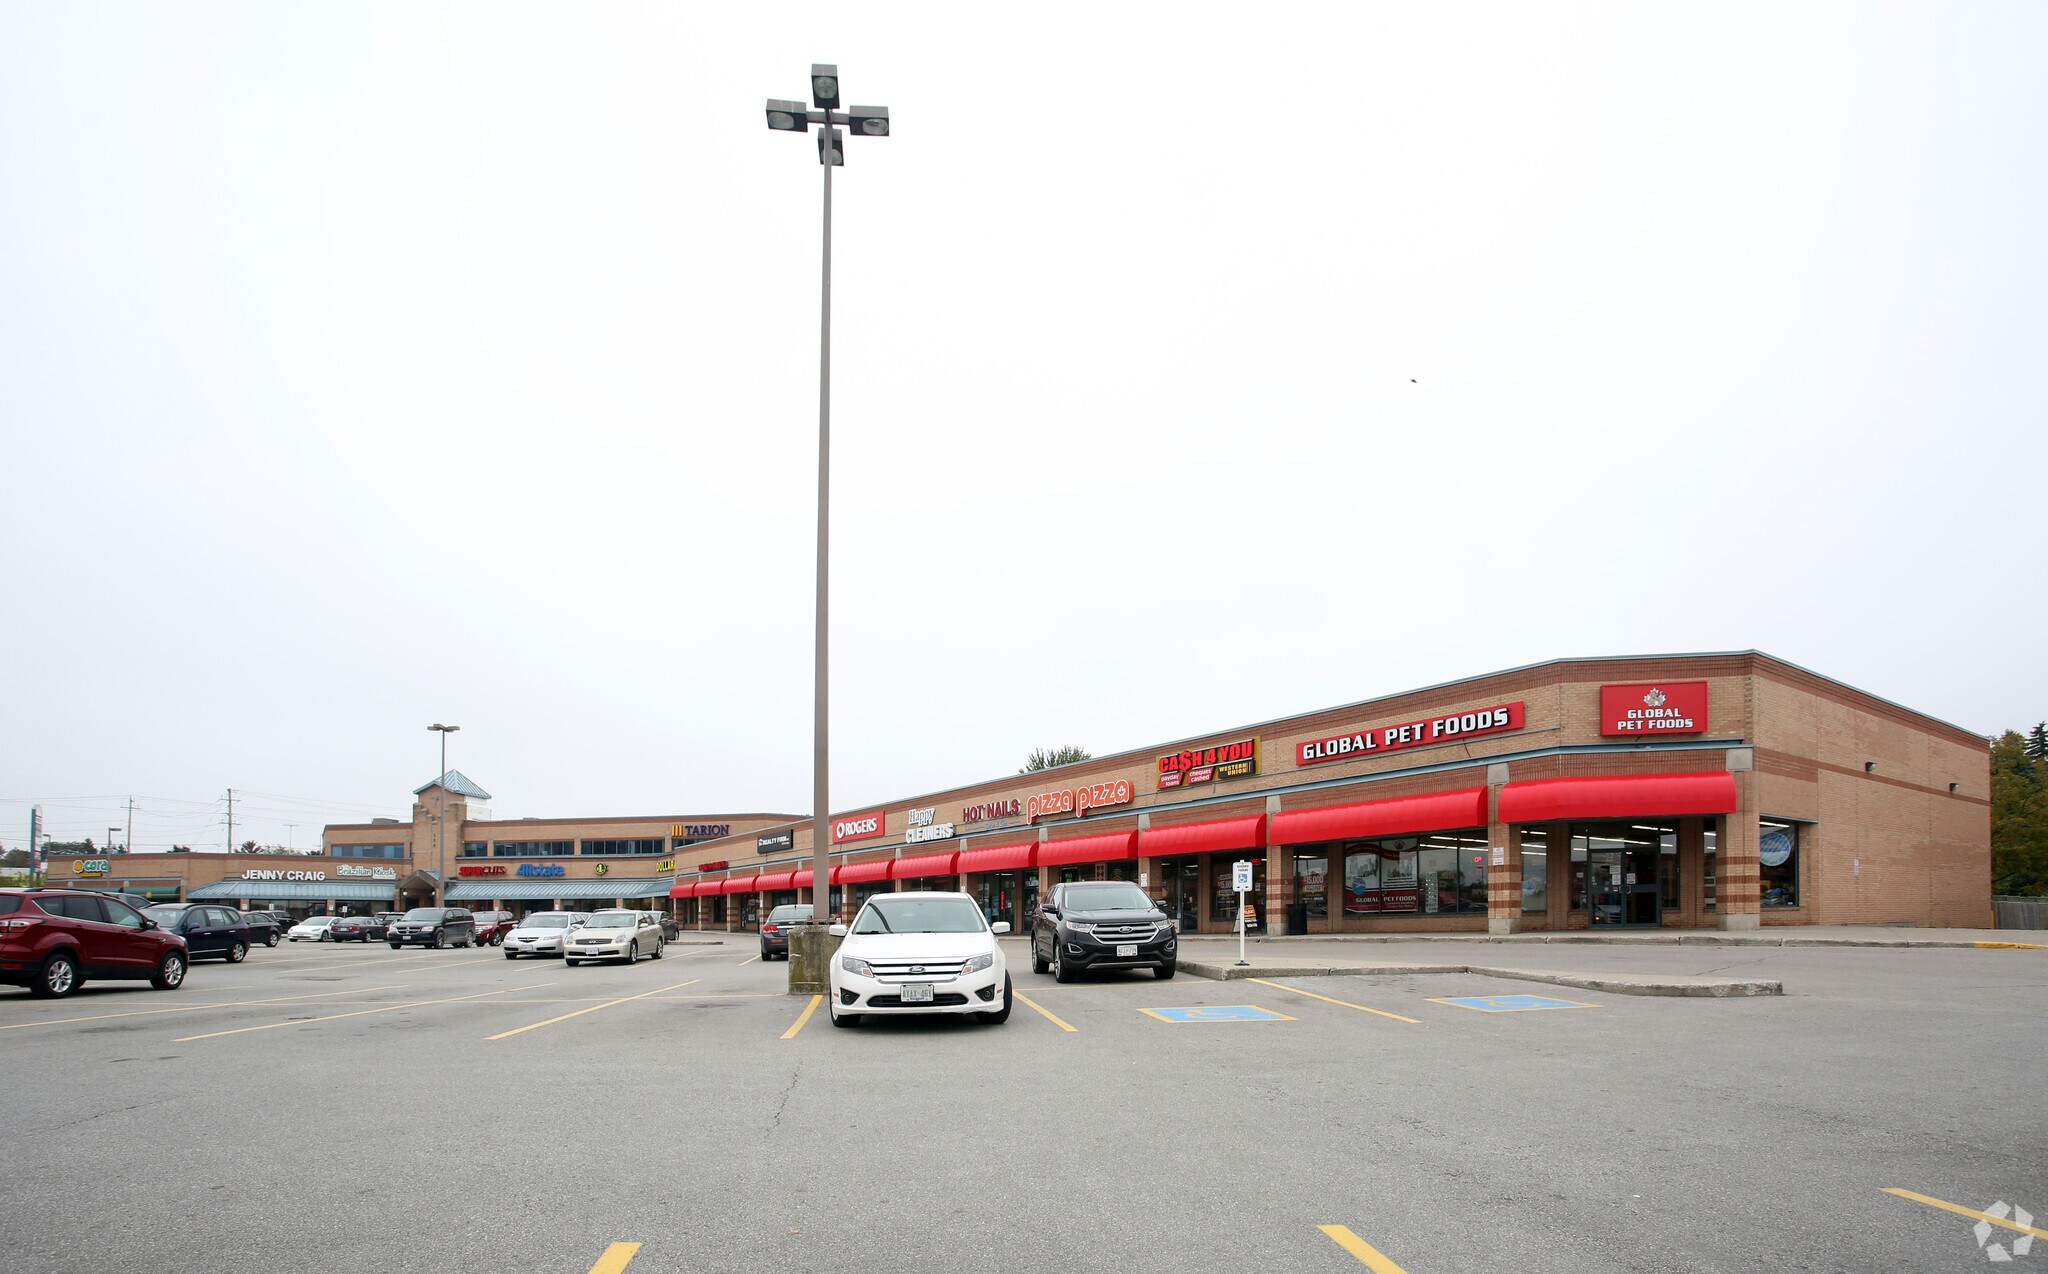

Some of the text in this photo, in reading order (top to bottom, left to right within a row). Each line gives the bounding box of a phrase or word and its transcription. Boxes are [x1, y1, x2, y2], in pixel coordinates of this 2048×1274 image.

[1627, 708, 1682, 719] GLOBAL
[1617, 718, 1694, 731] PET FOODS
[1302, 707, 1509, 760] GLOBAL PET FOODS
[1205, 747, 1218, 764] 4
[1219, 740, 1254, 761] YOU
[1189, 768, 1212, 777] cheques
[1218, 763, 1248, 772] WESTERN
[1227, 768, 1248, 776] UNION
[1160, 773, 1180, 782] payday
[1190, 774, 1210, 783] cashed
[963, 799, 1021, 822] HOT NAILS
[908, 808, 936, 826] Happy
[685, 825, 730, 836] TARION
[845, 818, 878, 836] ROGERS
[905, 823, 955, 844] CLEANERS
[241, 870, 326, 881] JENNY CRAIG
[337, 865, 396, 876] Brazilian Kiosk
[515, 863, 565, 877] Allstate
